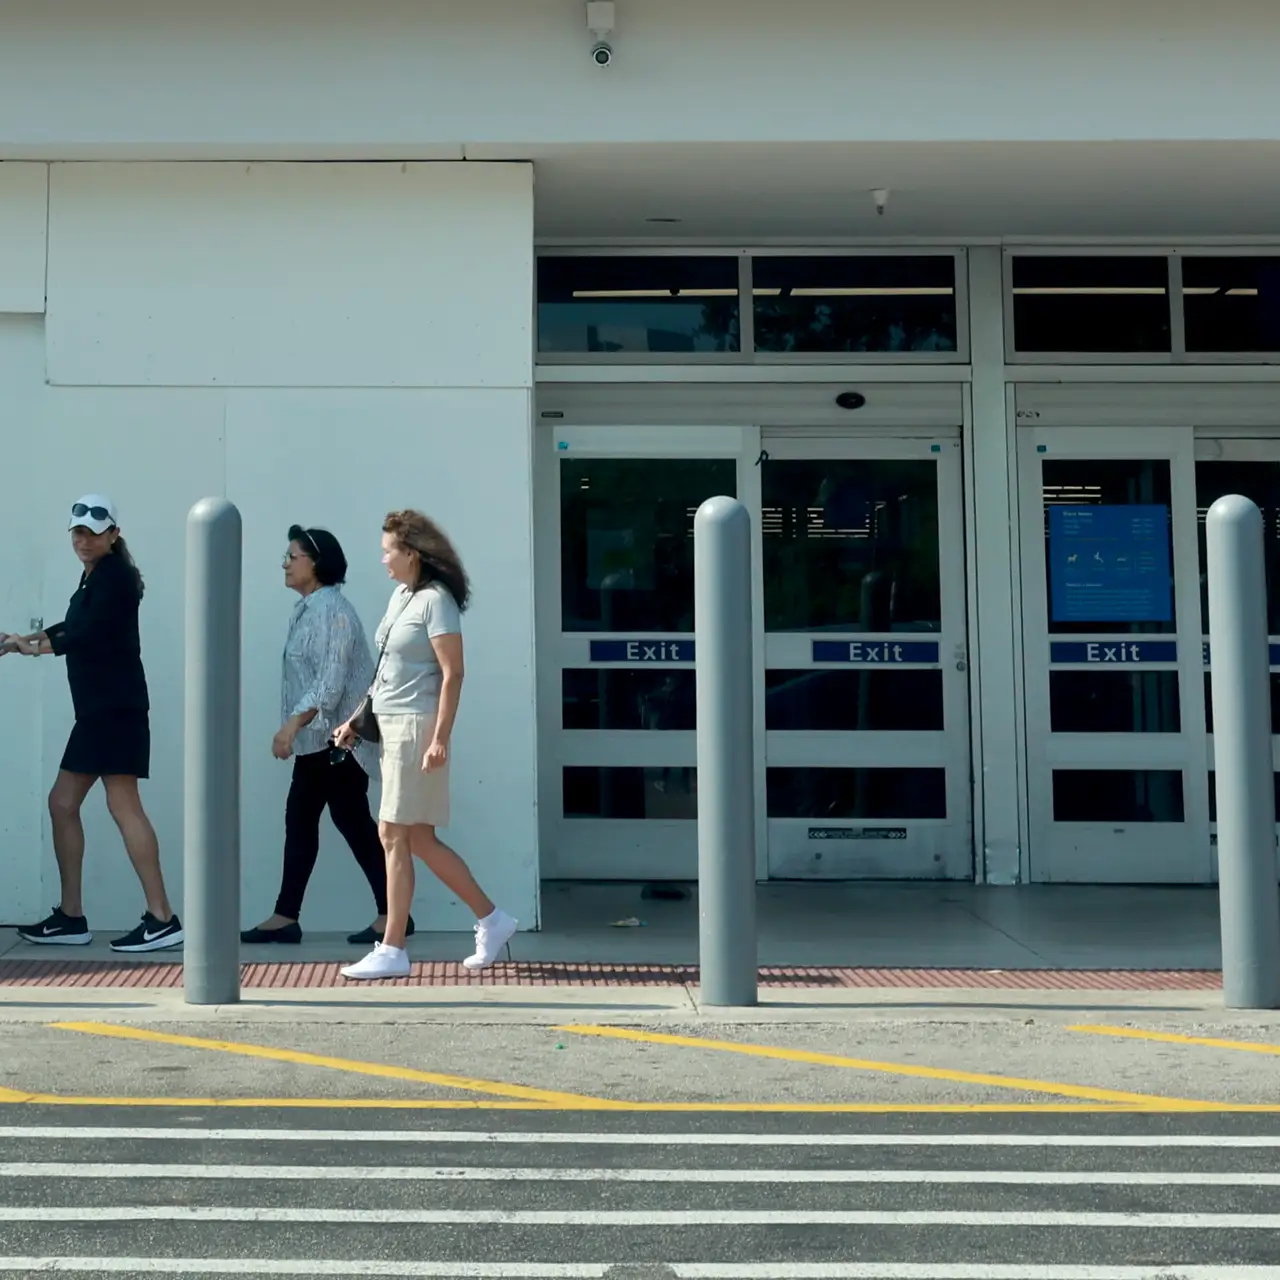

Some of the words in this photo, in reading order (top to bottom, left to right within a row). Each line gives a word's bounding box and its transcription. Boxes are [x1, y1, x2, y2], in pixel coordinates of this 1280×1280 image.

[626, 642, 680, 660] Exit
[849, 642, 903, 662] Exit
[1086, 643, 1140, 662] Exit
